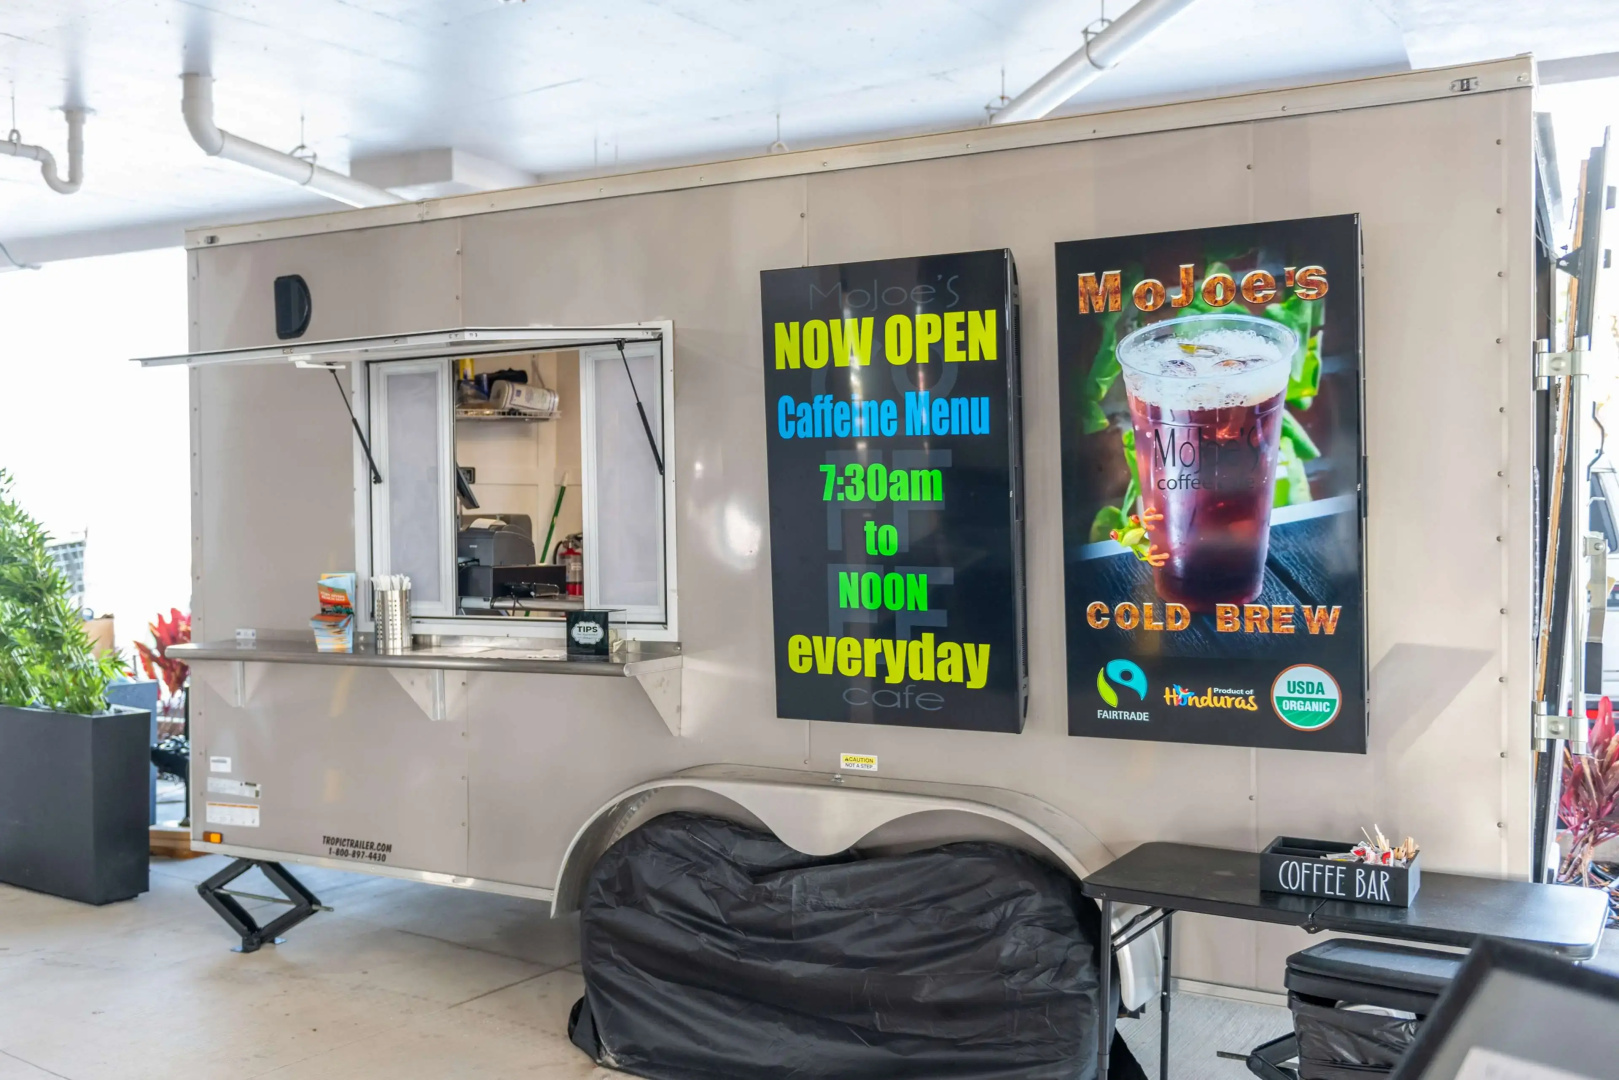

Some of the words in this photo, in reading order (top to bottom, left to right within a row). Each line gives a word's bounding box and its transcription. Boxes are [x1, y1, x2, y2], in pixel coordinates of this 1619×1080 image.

[1077, 263, 1329, 315] MoJoe's
[774, 316, 874, 370] NOW
[885, 309, 997, 366] OPEN
[777, 394, 898, 439] Caffeine
[905, 390, 990, 436] Menu
[819, 463, 943, 501] 7:30am
[864, 520, 899, 556] to
[838, 571, 928, 612] NOON
[577, 625, 598, 633] TIPS
[1086, 600, 1192, 632] COLD
[1215, 603, 1343, 635] BREW
[787, 632, 991, 690] everyday
[842, 684, 945, 711] cafe
[1163, 683, 1259, 711] Honduras
[1213, 687, 1242, 695] Product
[1287, 680, 1325, 695] USDA
[1096, 709, 1150, 722] FAIRTRADE
[1282, 699, 1331, 713] ORGANIC
[848, 756, 874, 764] CAUTION
[322, 835, 392, 853] TROPICTRAILER.COM
[328, 847, 387, 862] 1-800-897-4430
[1278, 860, 1347, 896] COFFEE
[1355, 868, 1391, 902] BAR
